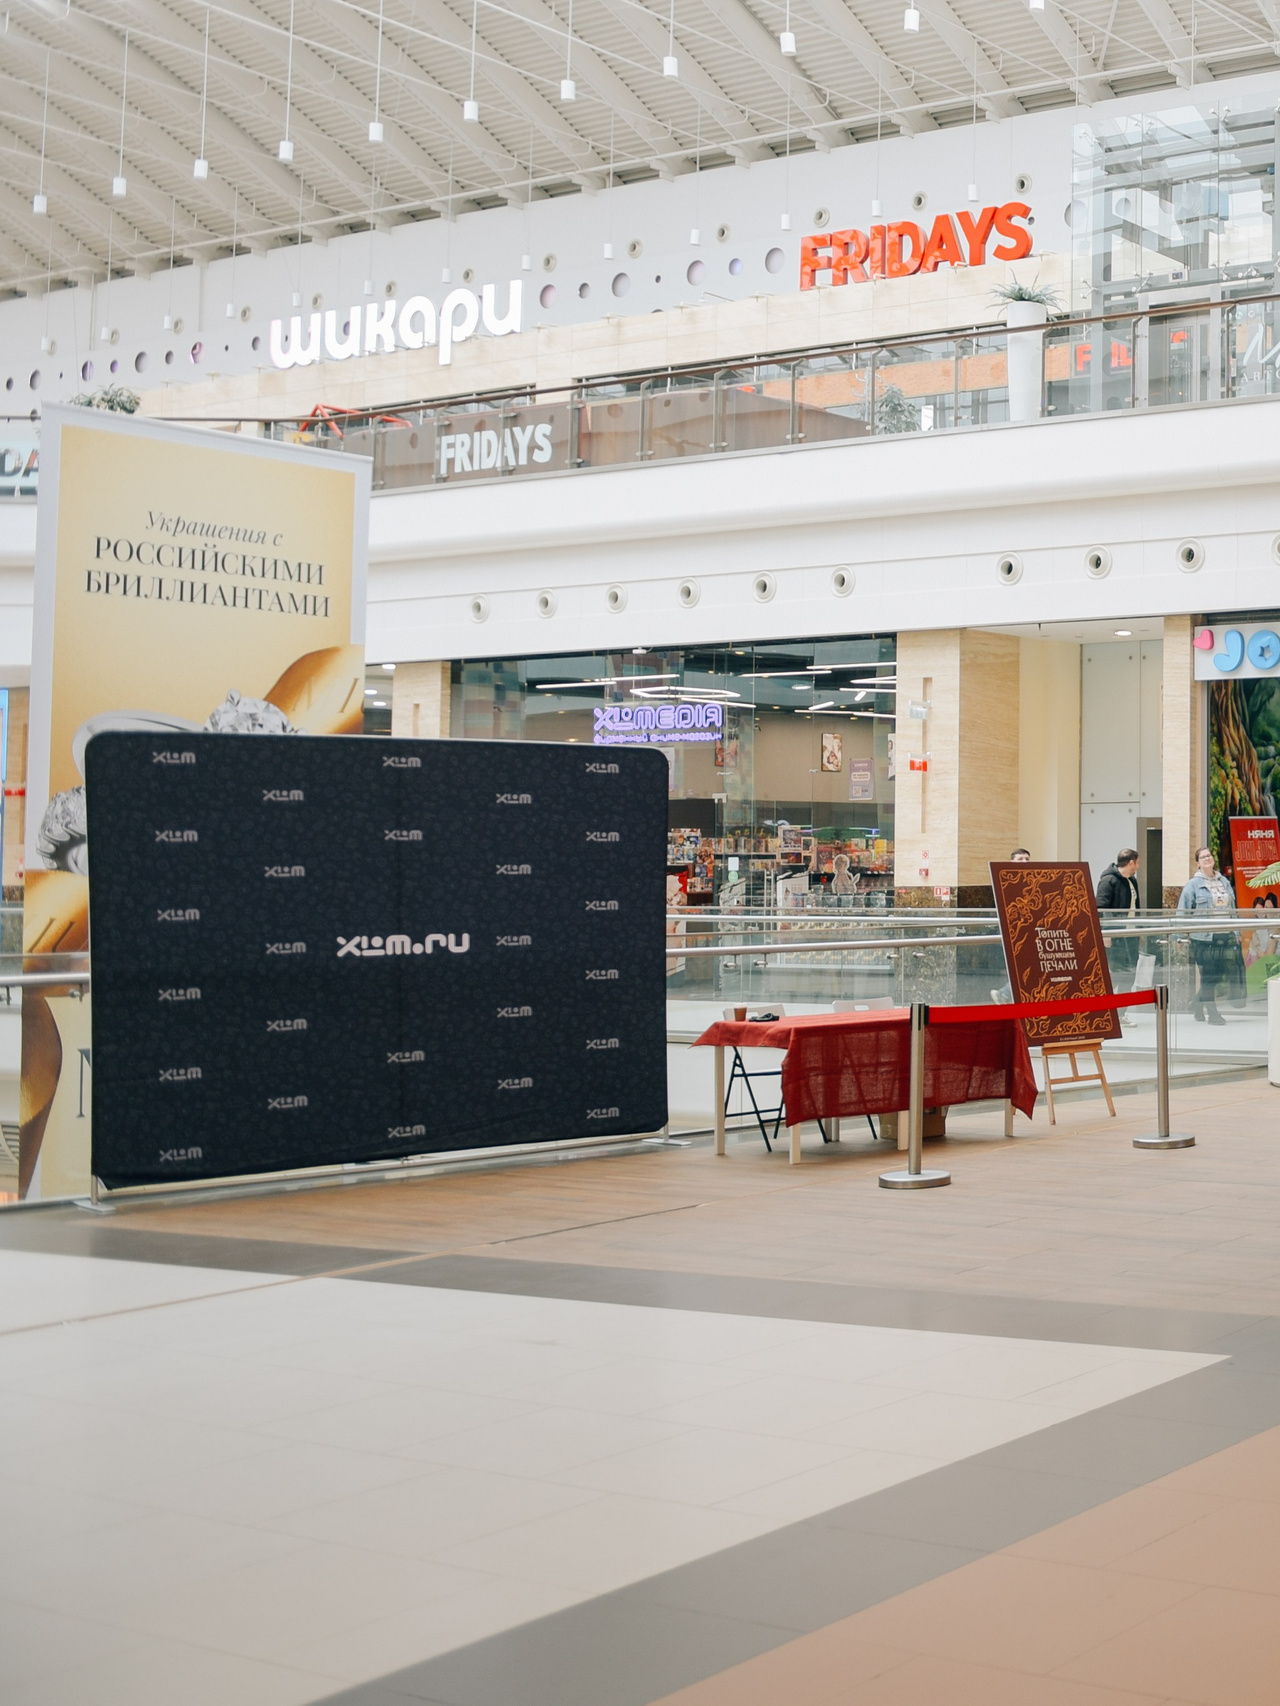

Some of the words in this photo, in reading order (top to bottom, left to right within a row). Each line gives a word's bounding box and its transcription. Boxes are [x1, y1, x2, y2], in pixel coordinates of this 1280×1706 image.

[800, 201, 1034, 291] FRIDAYS
[440, 424, 553, 475] FRIDAYS
[145, 511, 267, 545] Украшения
[272, 532, 284, 547] с
[94, 536, 325, 586] РОССИЙСКИМИ
[84, 569, 331, 618] БРИЛЛИАНТАМИ
[1247, 830, 1275, 838] НЯНЯ
[1045, 938, 1074, 951] ОГНЕ
[1040, 959, 1078, 973] ПЕЧАЛИ
